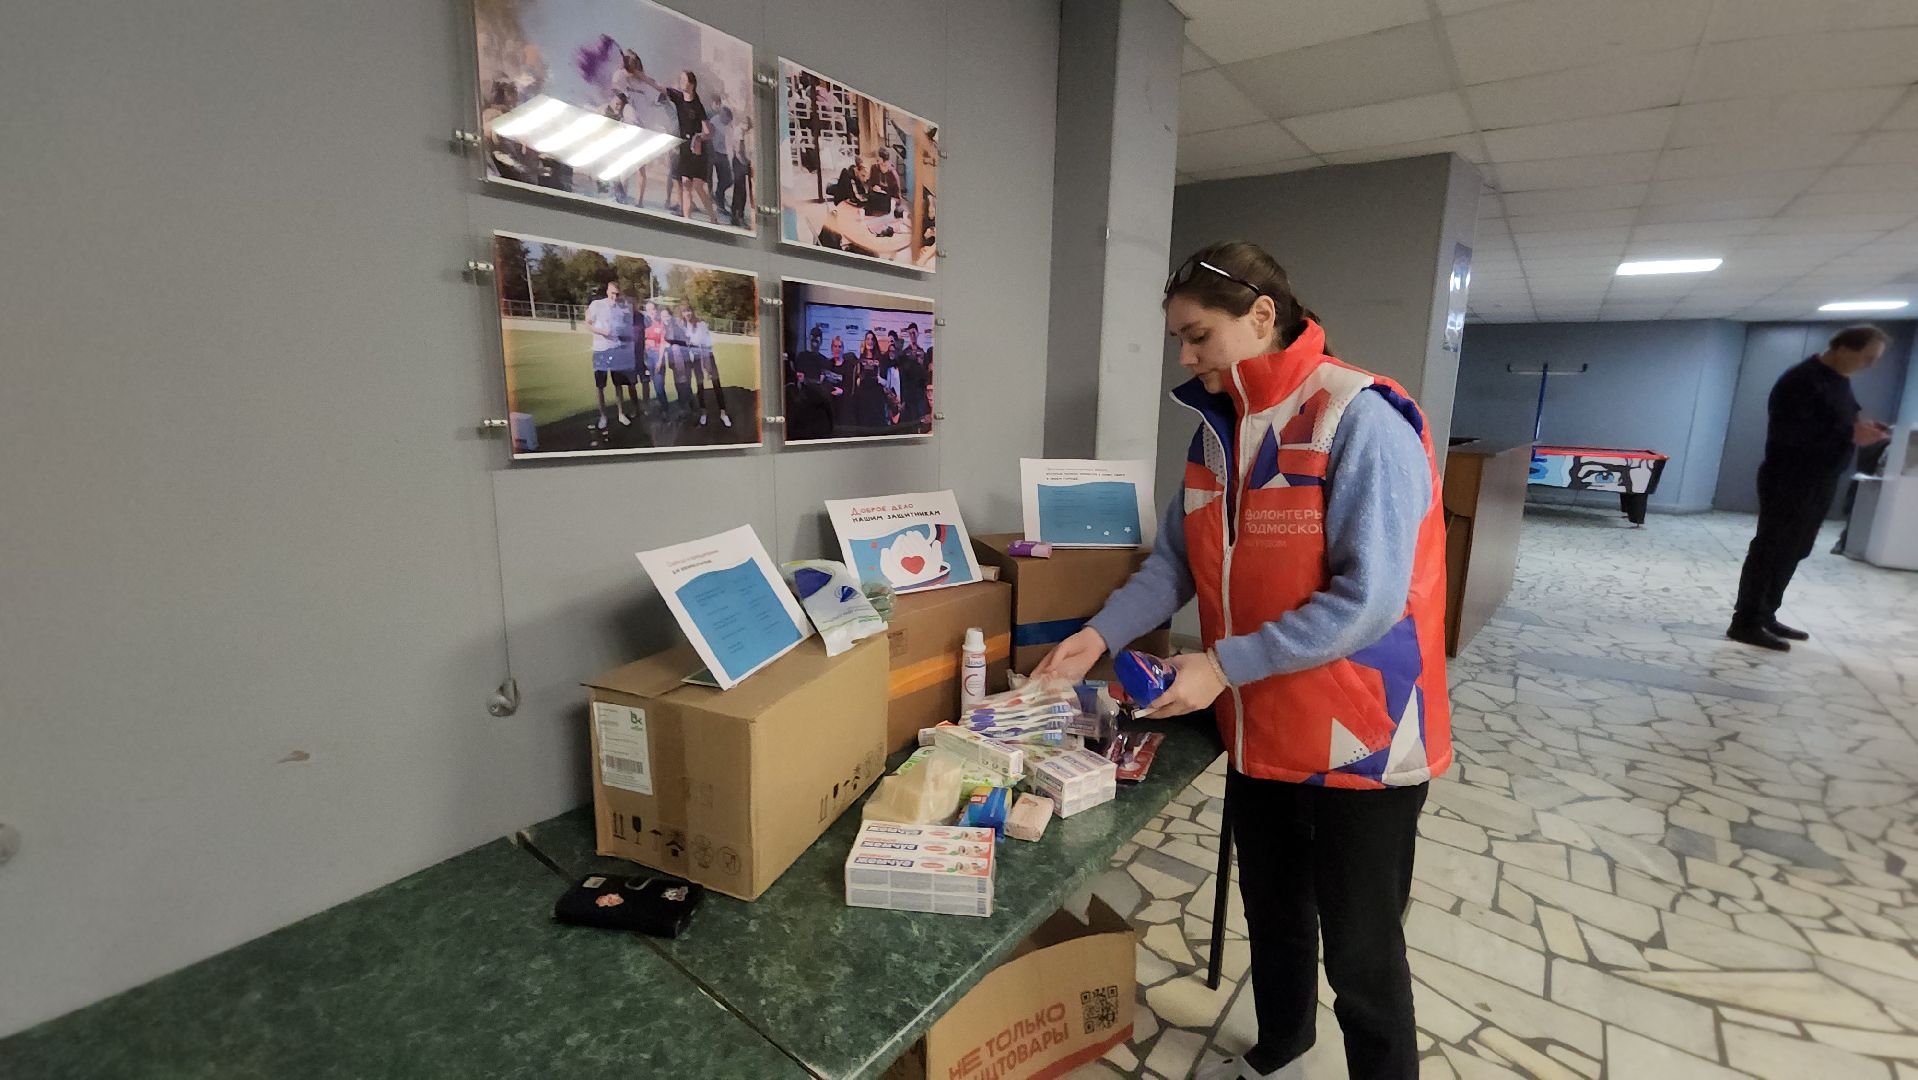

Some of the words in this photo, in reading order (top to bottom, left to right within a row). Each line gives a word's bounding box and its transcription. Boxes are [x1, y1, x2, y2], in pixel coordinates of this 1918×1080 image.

[852, 515, 884, 524] НАШИМ
[887, 510, 941, 520] ЗАЩИТНИКАМ
[1244, 522, 1323, 535] ПОДМОСКО
[984, 1002, 1067, 1058] ТОЛЬКО
